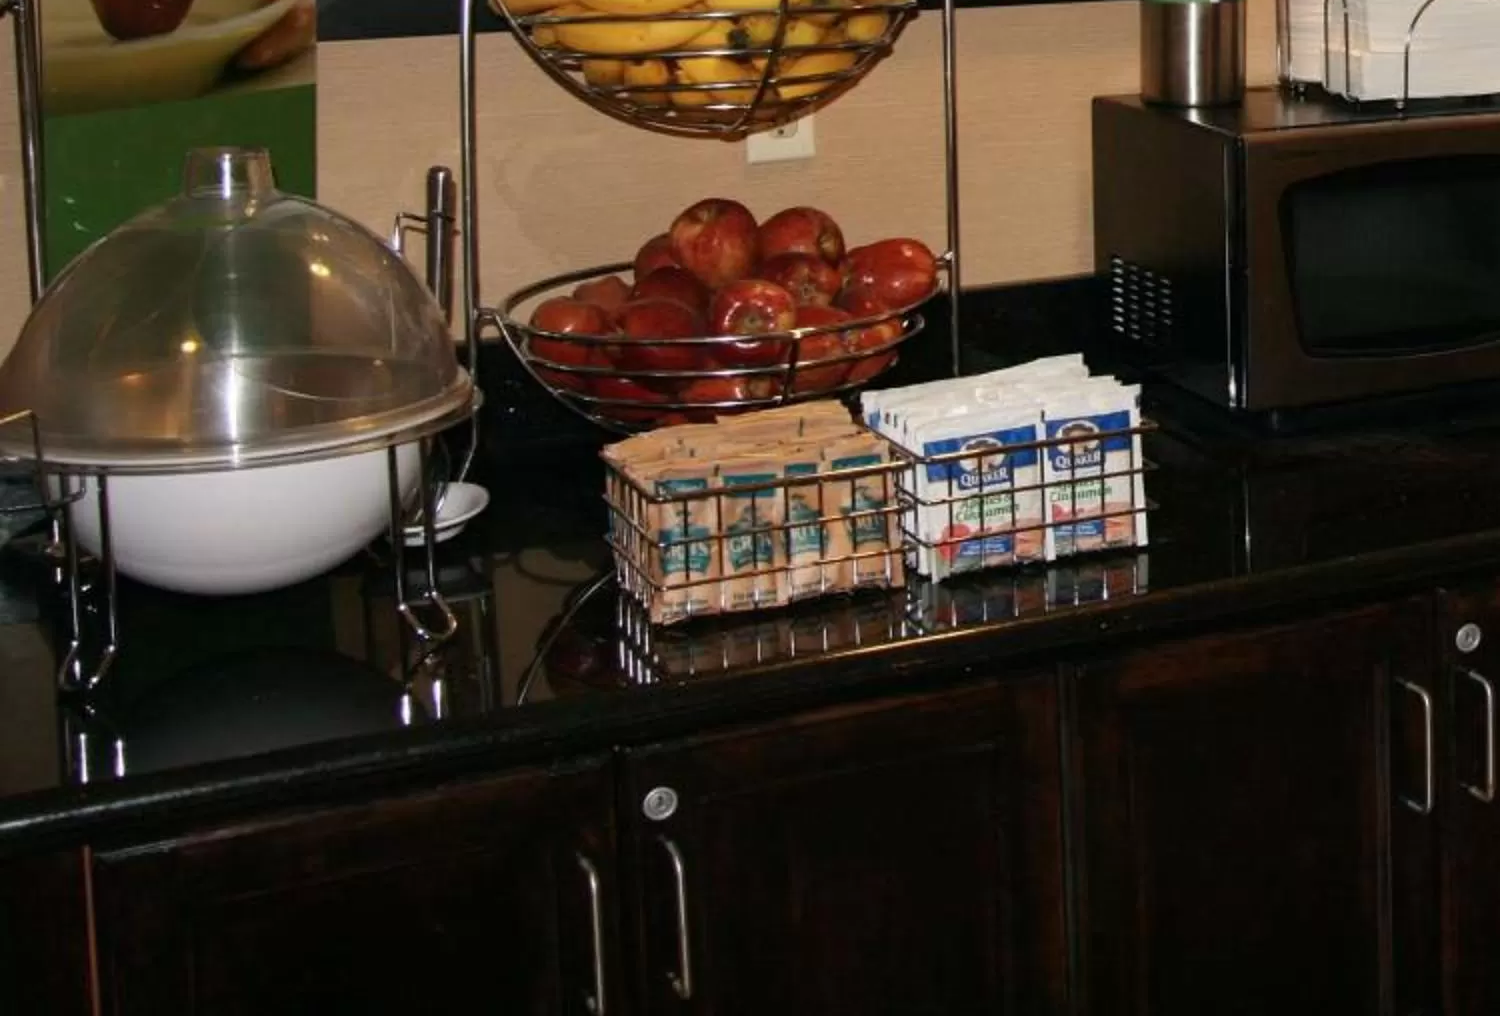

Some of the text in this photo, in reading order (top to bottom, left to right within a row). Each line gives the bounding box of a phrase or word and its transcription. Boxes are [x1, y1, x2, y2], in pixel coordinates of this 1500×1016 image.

[1055, 451, 1101, 469] QUAKER
[959, 467, 1009, 487] QUAKER
[1049, 485, 1113, 502] Cinamon
